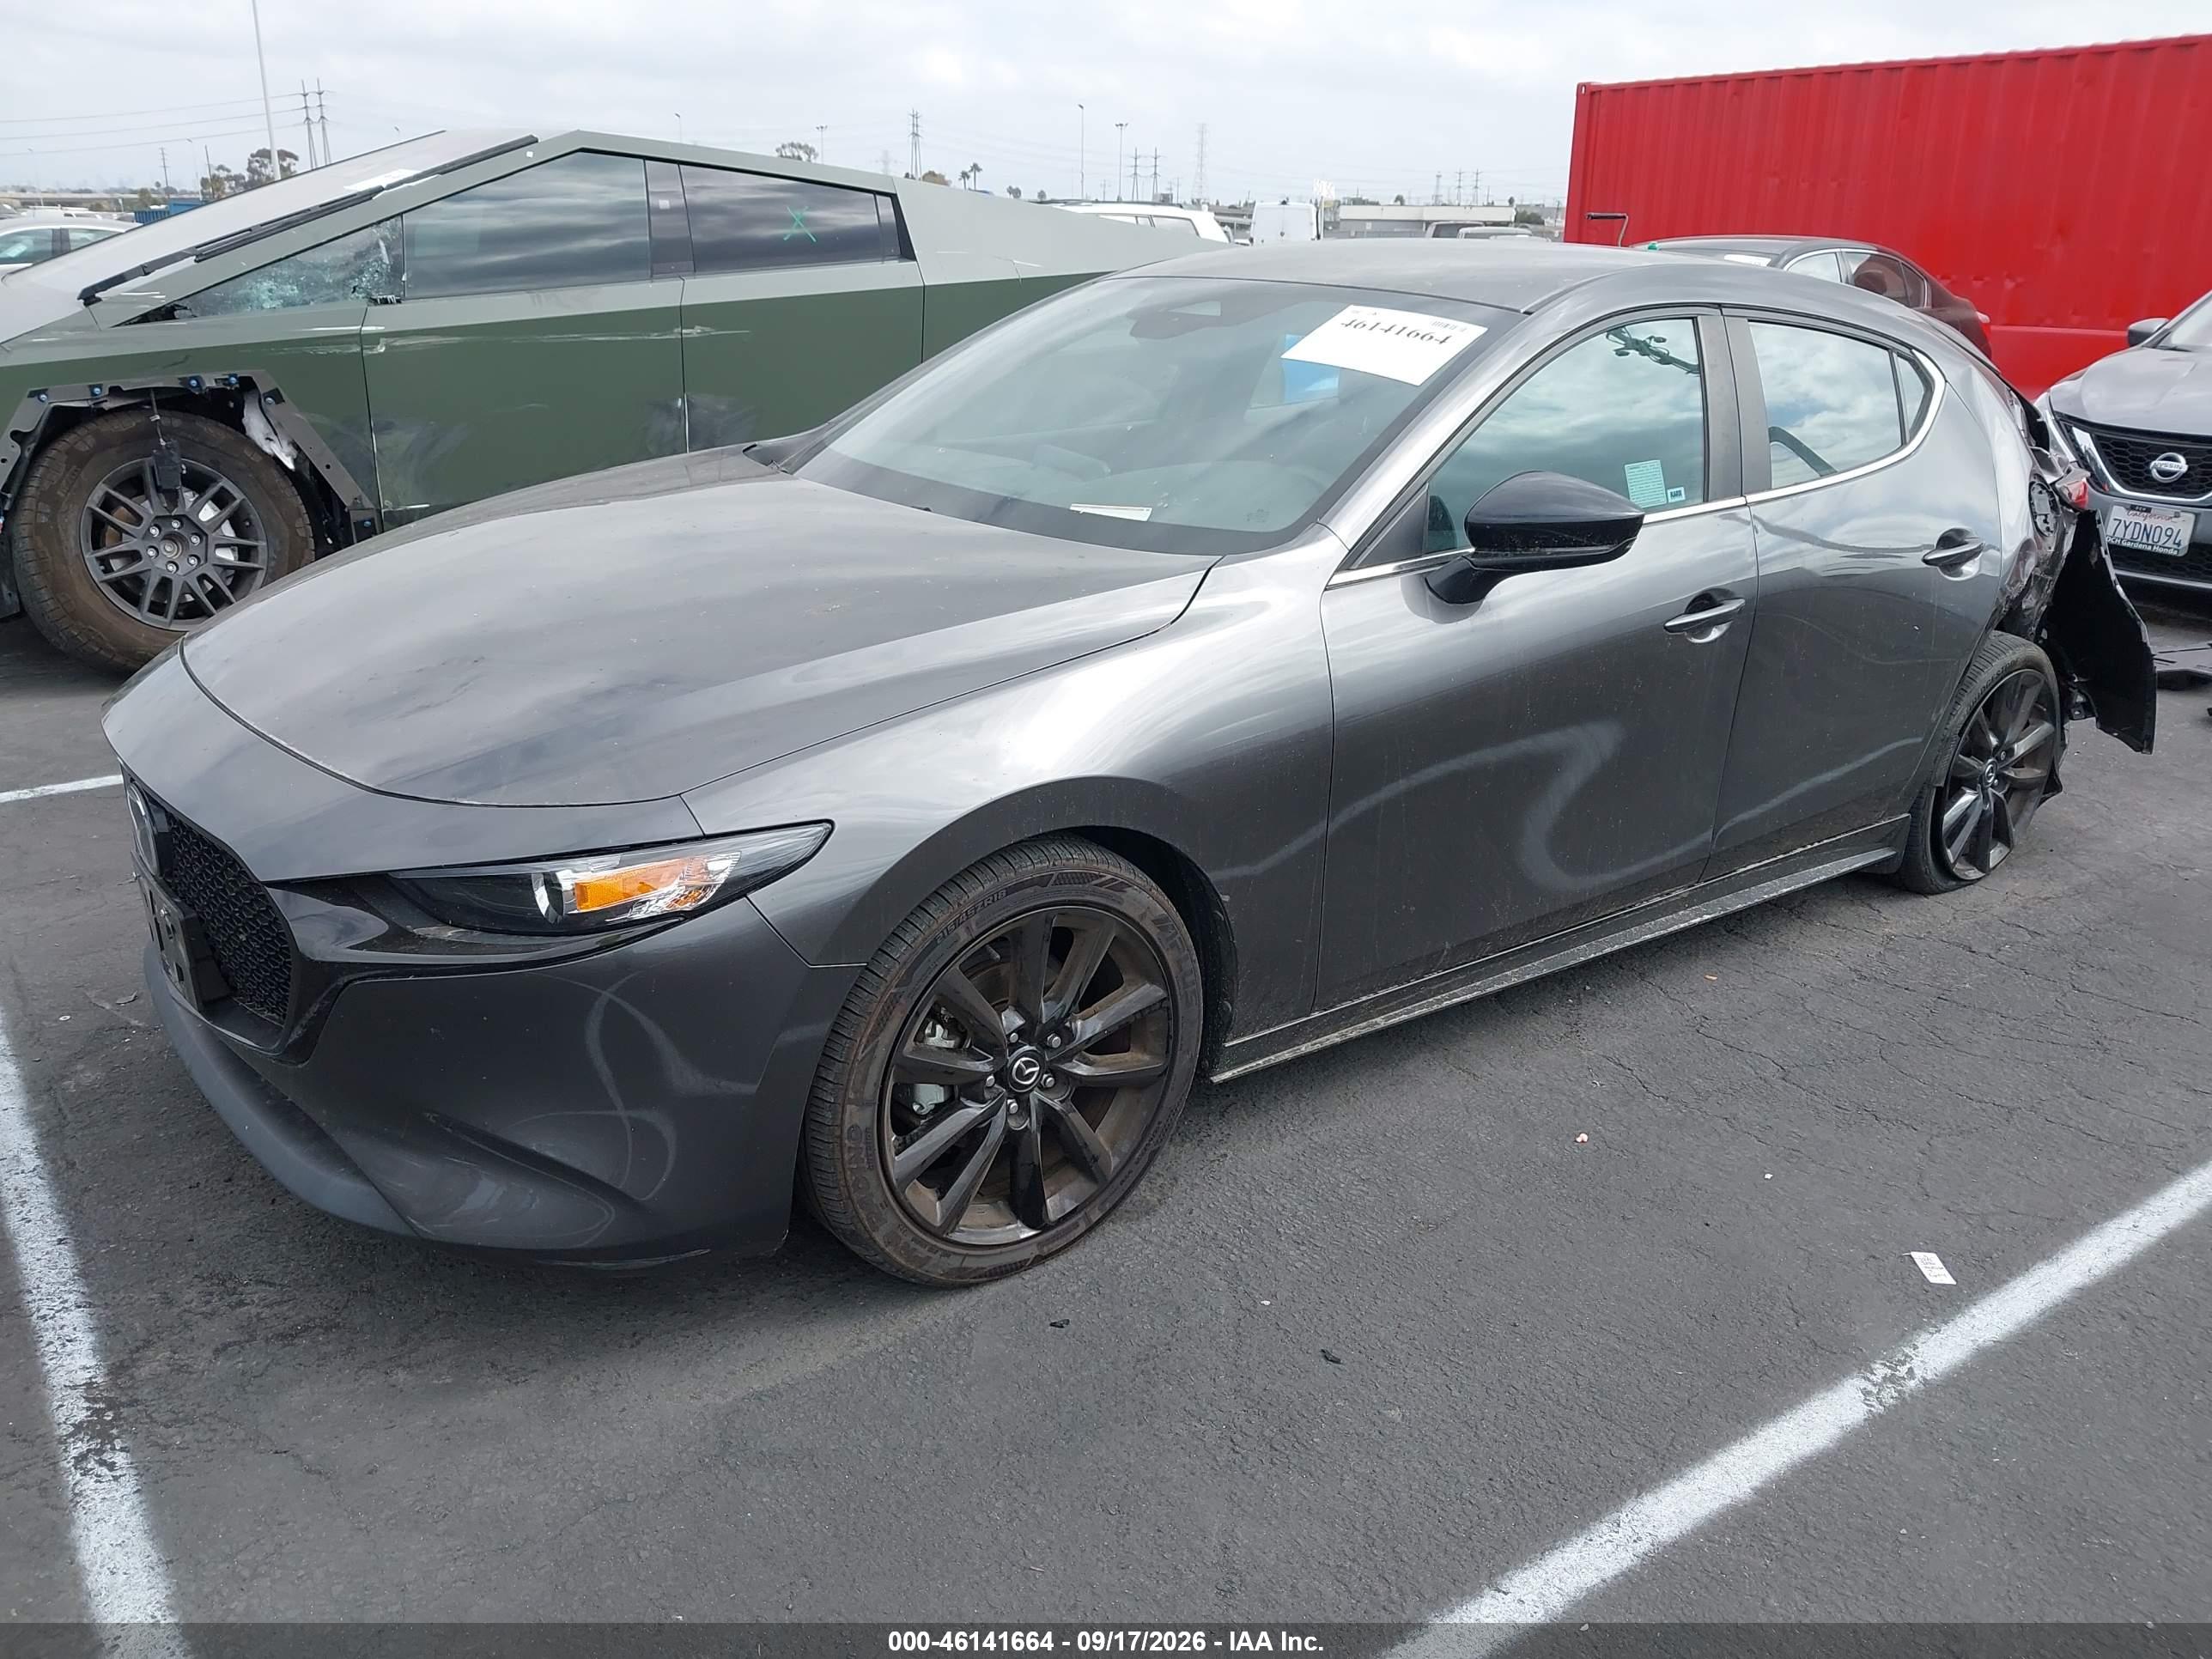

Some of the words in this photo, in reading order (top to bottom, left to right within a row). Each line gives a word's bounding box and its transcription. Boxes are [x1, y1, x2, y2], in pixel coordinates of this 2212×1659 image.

[1340, 319, 1453, 344] 46141664
[2106, 536, 2121, 544] DCH
[2121, 539, 2152, 551] Gardena
[2153, 545, 2179, 555] Honda
[2112, 518, 2182, 548] 7YDN094
